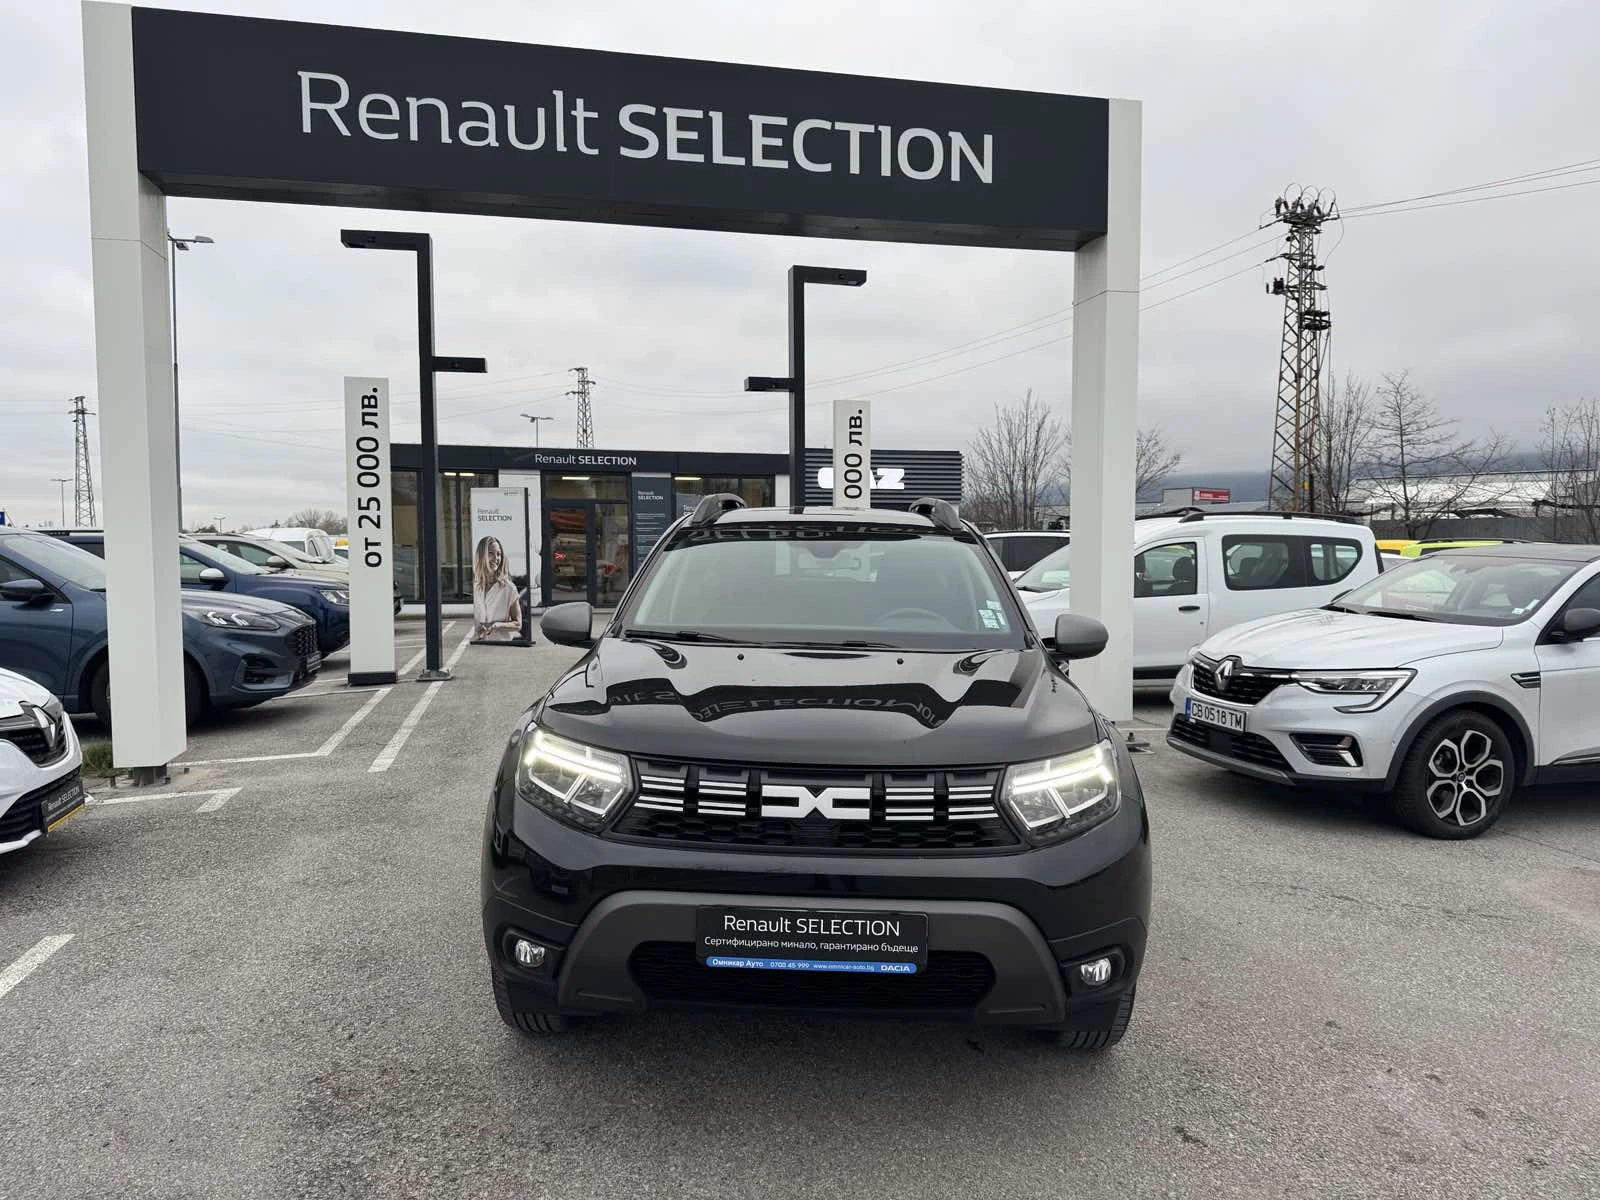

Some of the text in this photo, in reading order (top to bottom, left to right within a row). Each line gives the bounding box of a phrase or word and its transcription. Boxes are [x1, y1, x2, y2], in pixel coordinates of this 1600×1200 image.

[297, 70, 994, 185] Renault SELECTION
[361, 387, 379, 429] лв.
[356, 436, 380, 488] 000
[534, 453, 637, 466] Renault SELECTION
[843, 408, 863, 499] 000 лв.
[357, 496, 381, 530] 25
[1204, 706, 1227, 725] 0518
[723, 915, 900, 937] Renault SELECTION
[704, 936, 919, 954] Сертифицирано минало, гарантирано бъдеще
[880, 964, 911, 973] DACIA
